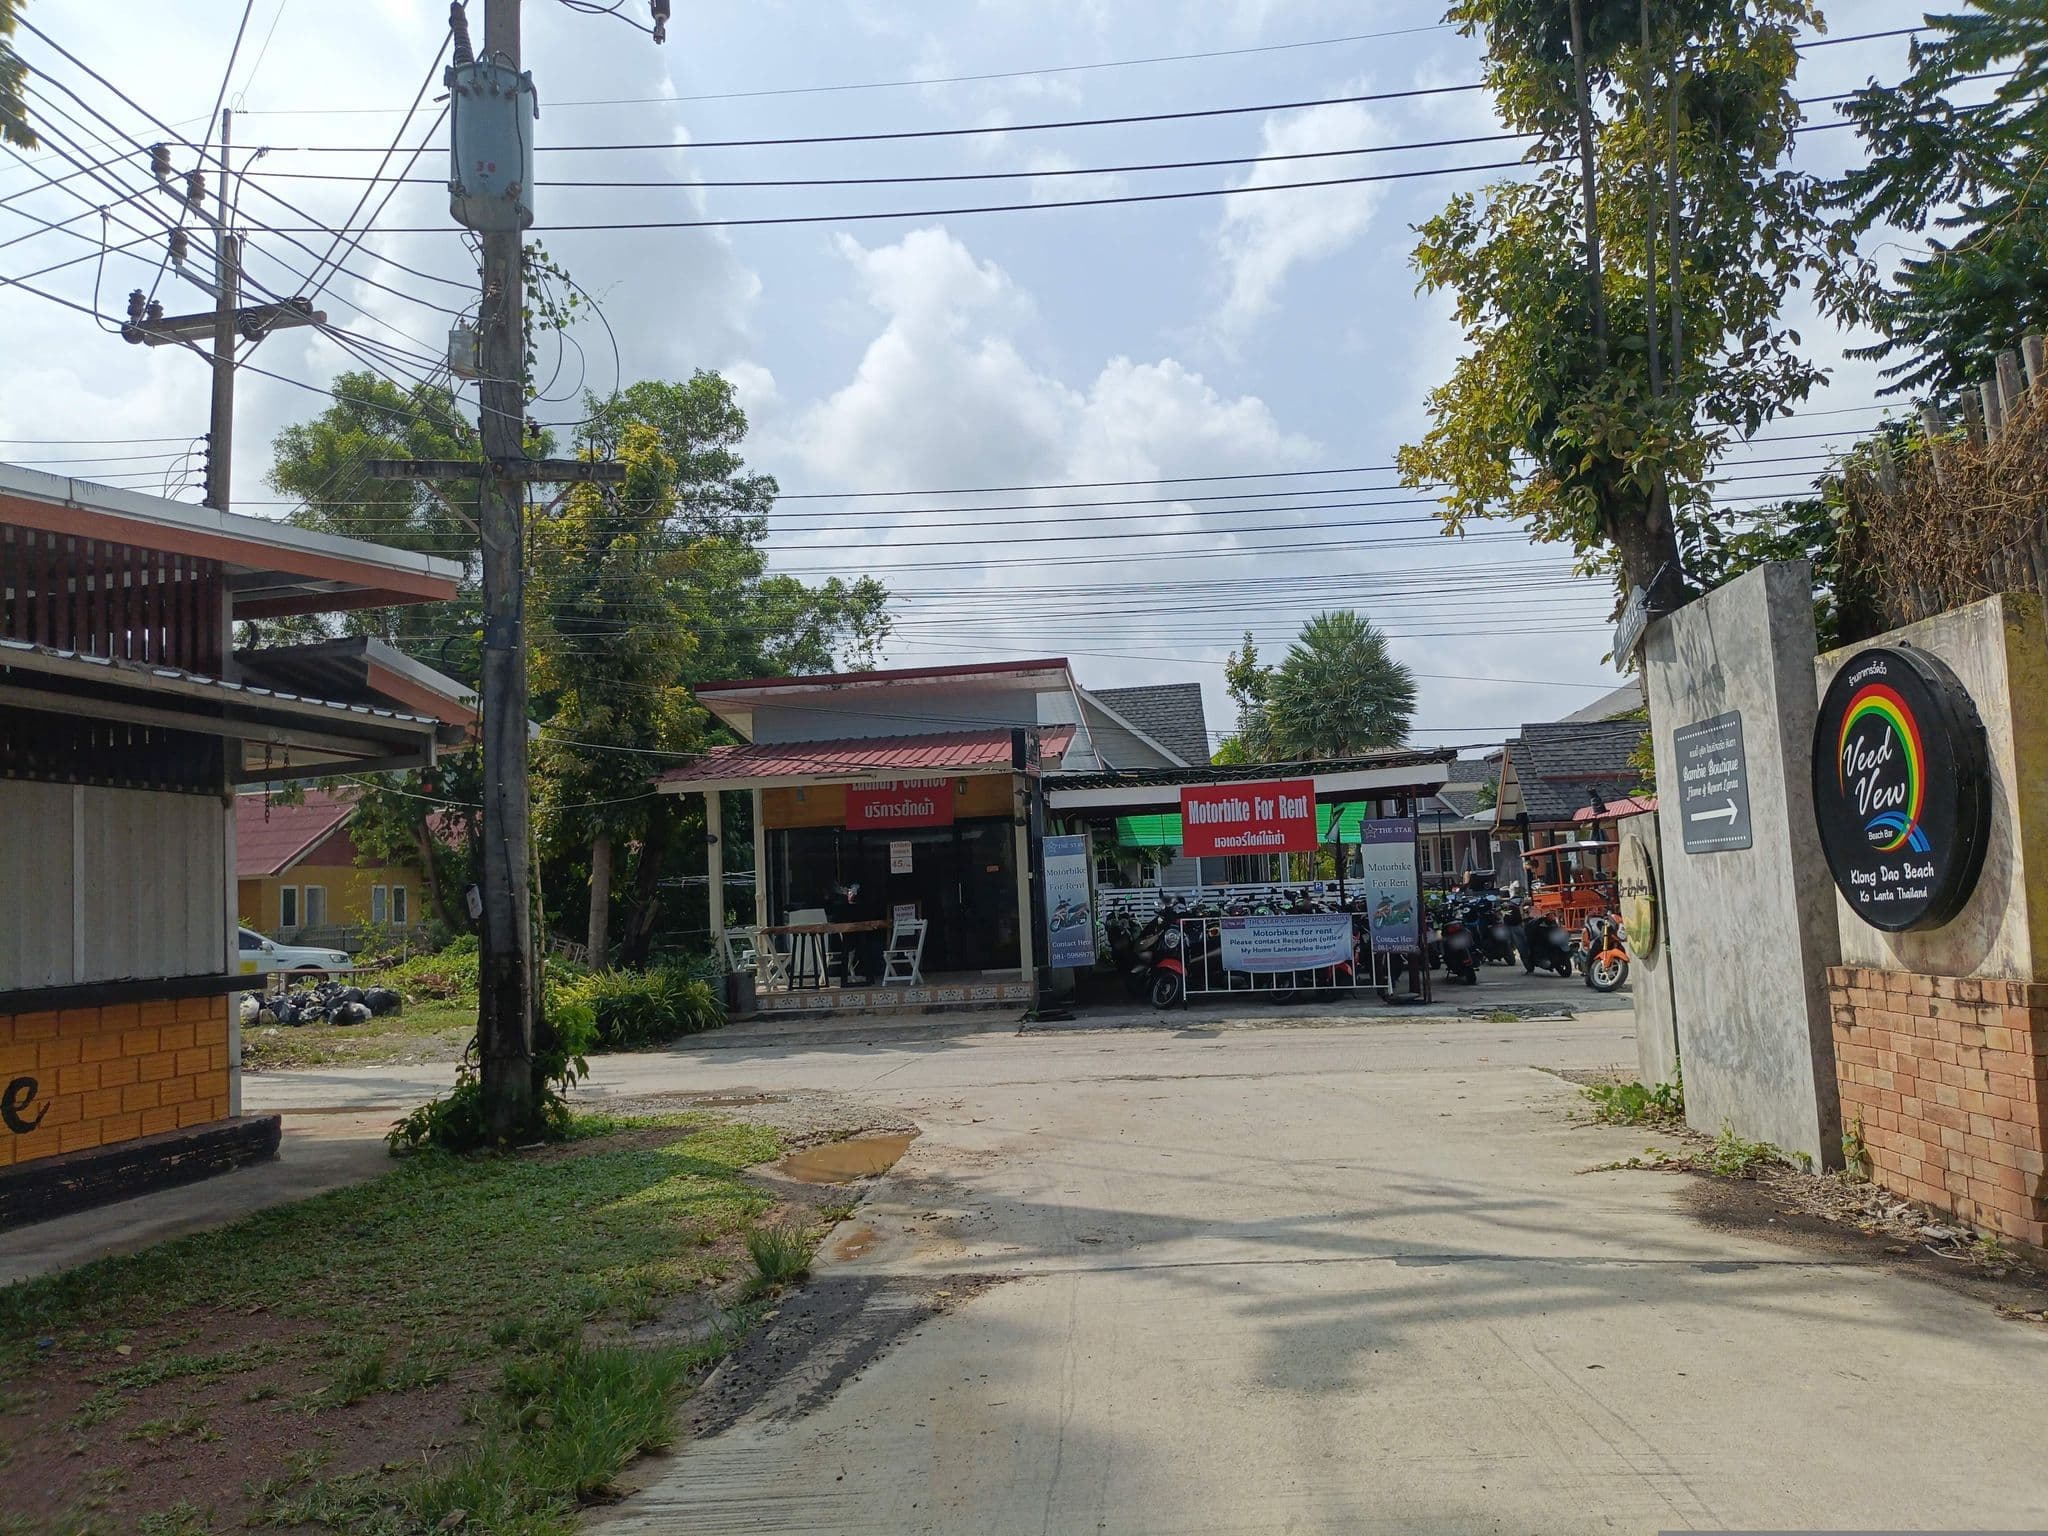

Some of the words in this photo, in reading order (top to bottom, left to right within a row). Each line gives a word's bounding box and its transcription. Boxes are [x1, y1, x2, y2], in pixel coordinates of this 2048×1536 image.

[1843, 726, 1892, 777] Veed
[1708, 758, 1739, 776] Boutique
[1855, 768, 1905, 815] Vew
[1188, 798, 1250, 824] Motorbike
[1255, 796, 1274, 820] For
[1279, 795, 1308, 819] Rent
[1868, 831, 1883, 840] Beach
[1884, 829, 1893, 838] Bar
[1046, 867, 1086, 876] Motorbike
[1368, 862, 1411, 871] Motorbike
[1850, 869, 1876, 886] Klong
[1880, 865, 1899, 881] Dao
[1903, 861, 1934, 879] Beach
[1066, 882, 1085, 890] Rent
[1372, 879, 1386, 887] For
[1390, 879, 1408, 887] Rent
[1860, 890, 1870, 902] Ko
[1873, 890, 1894, 901] Lanta
[1897, 886, 1928, 900] Thailand
[1253, 929, 1299, 937] Motorbikes
[1301, 928, 1313, 936] for
[1316, 927, 1332, 935] rent
[1052, 940, 1076, 948] Contact
[1282, 937, 1317, 945] Reception
